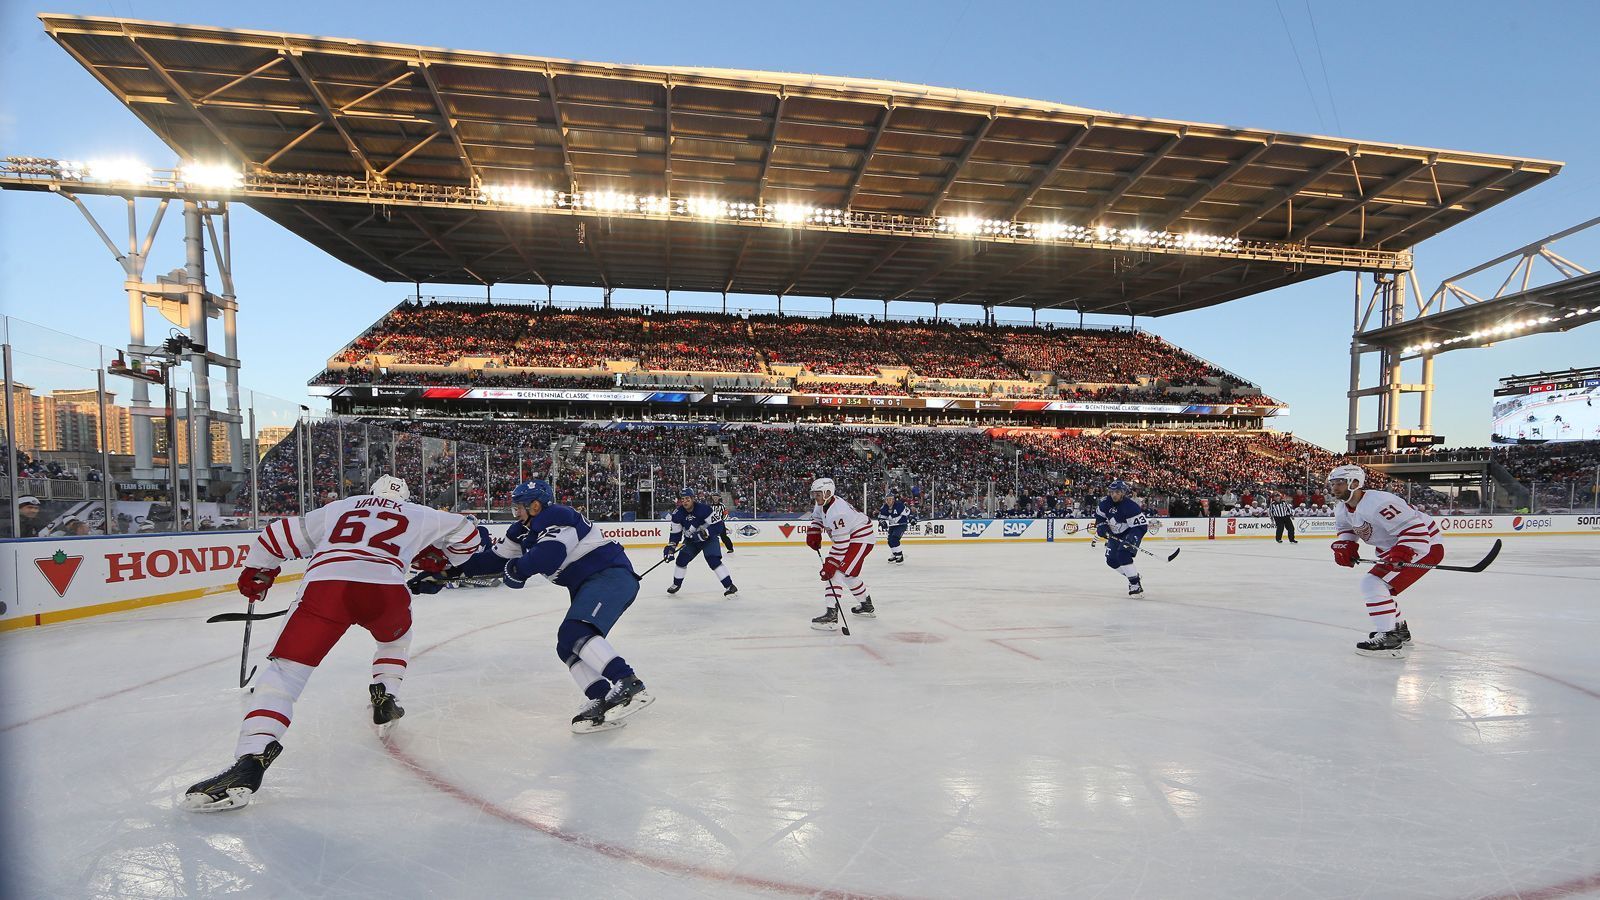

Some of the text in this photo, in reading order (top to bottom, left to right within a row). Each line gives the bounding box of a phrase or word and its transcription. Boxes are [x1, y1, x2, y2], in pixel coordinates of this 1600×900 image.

[390, 482, 401, 493] 62
[354, 498, 403, 513] VANEK
[1379, 504, 1402, 520] 51
[832, 518, 845, 530] 14
[1133, 515, 1147, 525] 43
[1453, 519, 1493, 529] ROGERS
[1525, 518, 1552, 529] pepsi
[328, 509, 410, 557] 62
[934, 524, 945, 534] 88
[962, 522, 986, 534] SAP
[1004, 522, 1027, 534] SAP
[104, 544, 251, 584] HONDA
